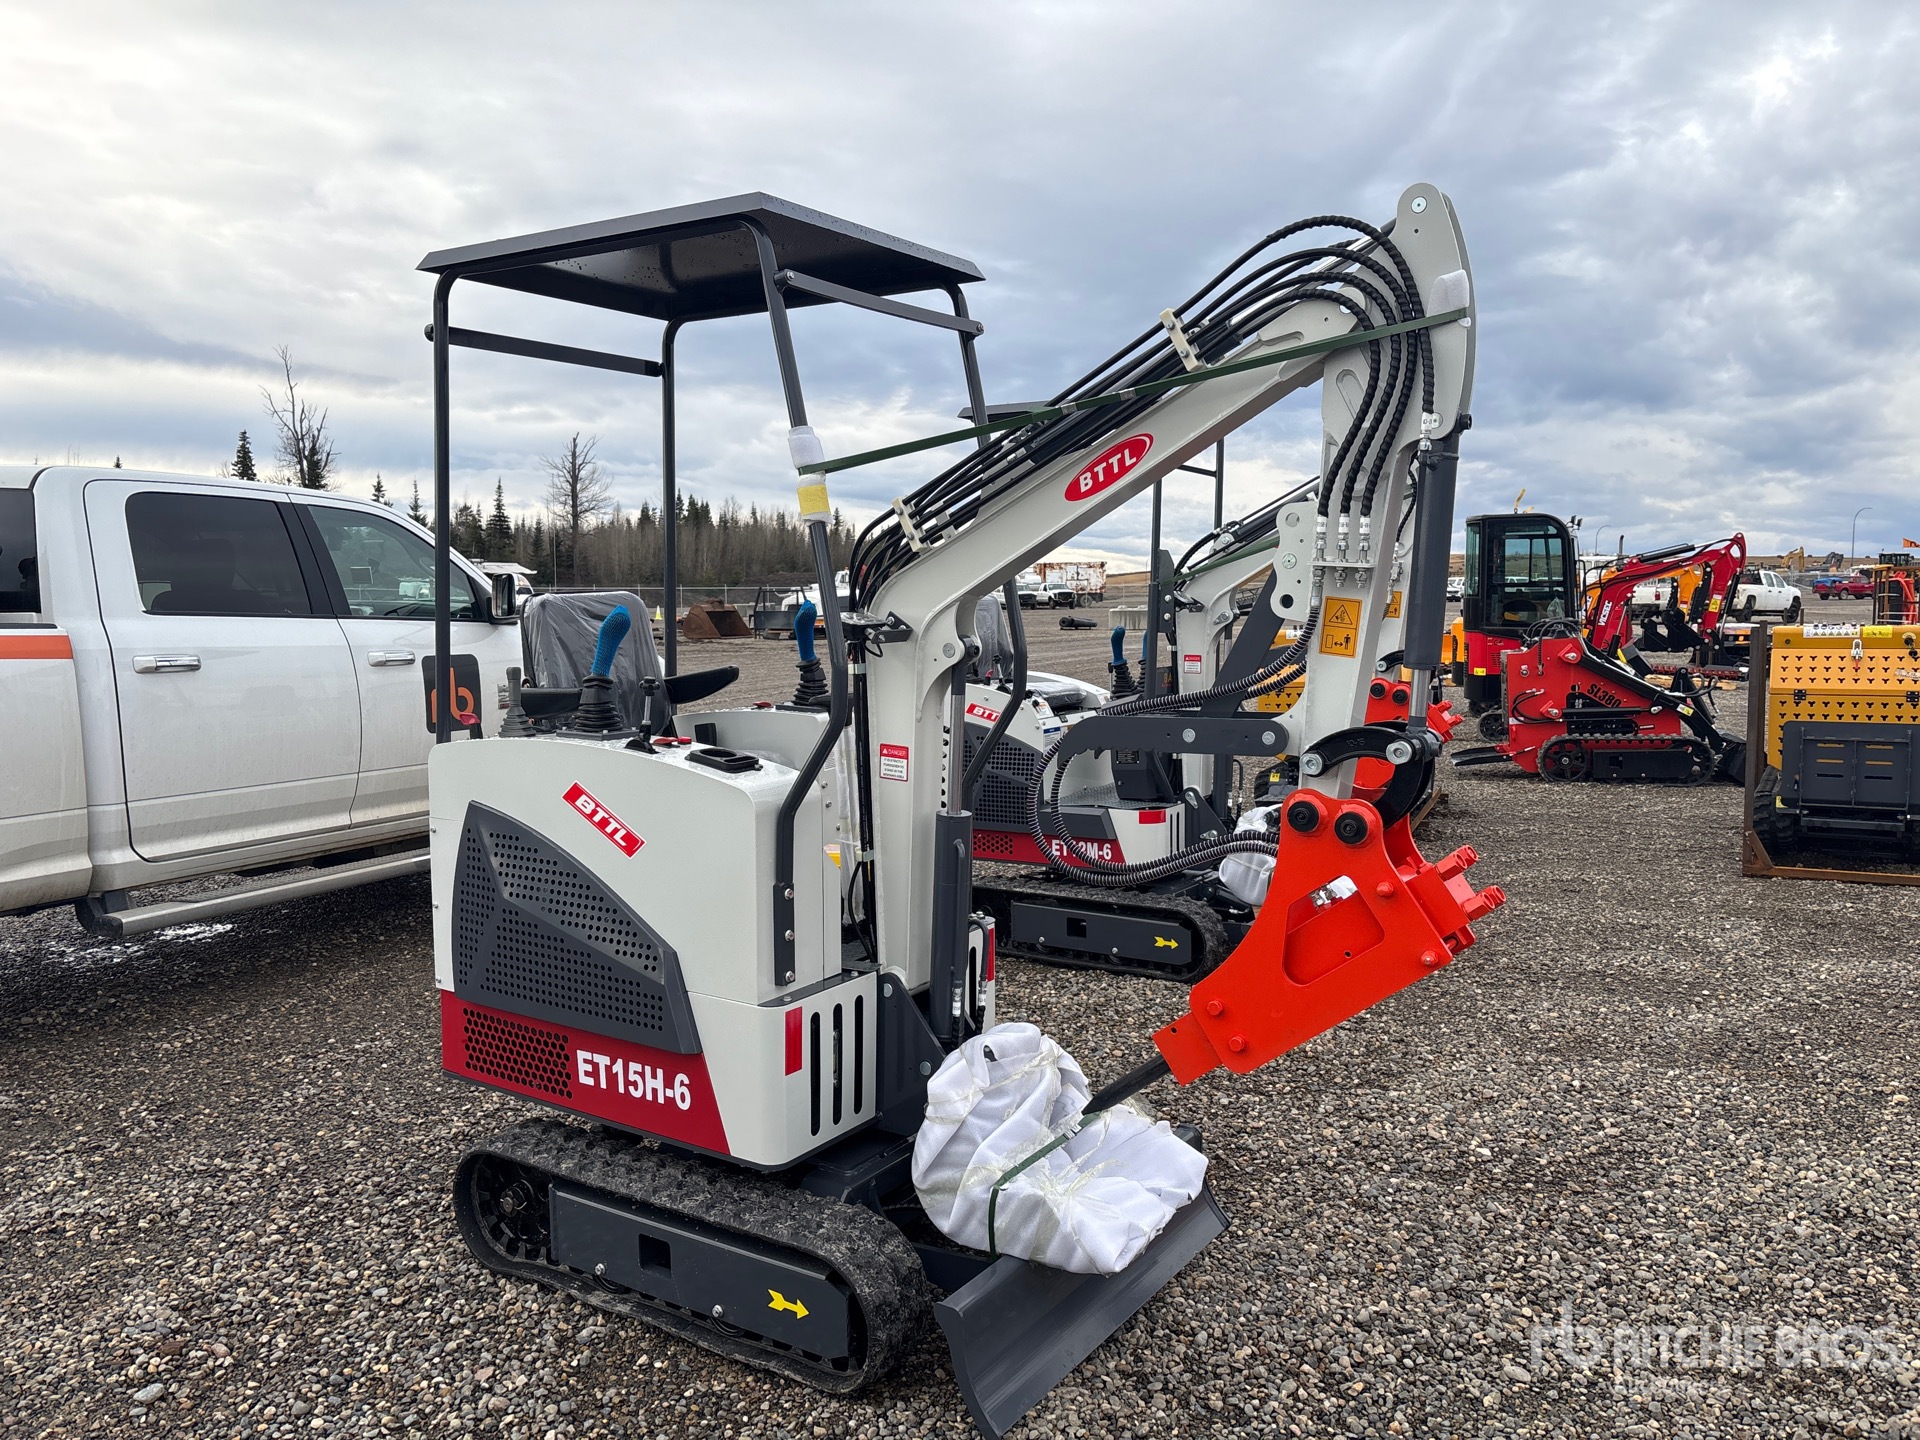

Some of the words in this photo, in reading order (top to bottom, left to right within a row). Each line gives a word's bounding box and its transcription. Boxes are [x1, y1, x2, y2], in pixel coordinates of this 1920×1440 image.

[1079, 448, 1137, 493] BTTL
[1587, 684, 1622, 708] SL380
[972, 706, 1000, 721] BTT
[574, 793, 627, 846] BTTL
[1052, 839, 1112, 860] ET2M-6
[576, 1049, 691, 1111] ET15H-6
